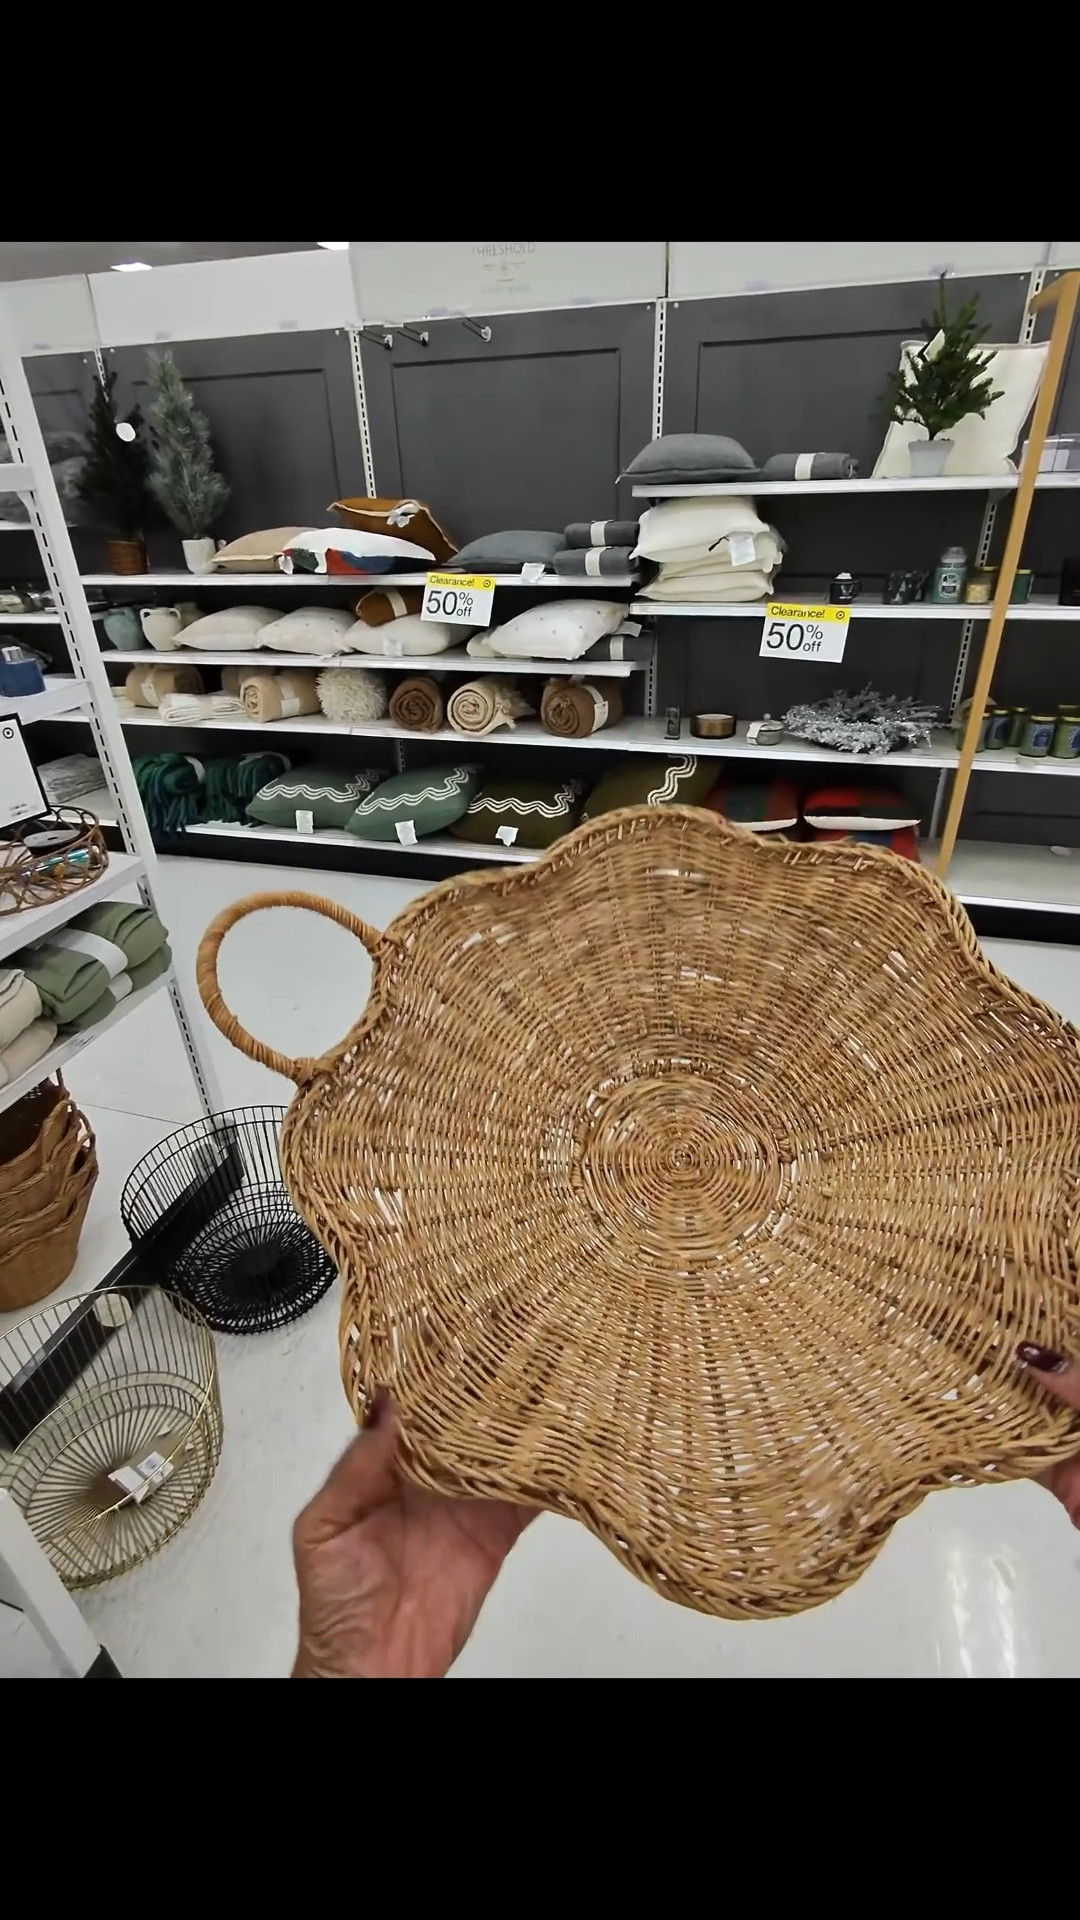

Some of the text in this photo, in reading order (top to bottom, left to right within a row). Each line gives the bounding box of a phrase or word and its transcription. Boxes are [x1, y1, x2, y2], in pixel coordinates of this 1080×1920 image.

[429, 575, 475, 587] Clearance!
[456, 607, 472, 617] off
[771, 606, 825, 618] Clearance!
[802, 641, 821, 652] off
